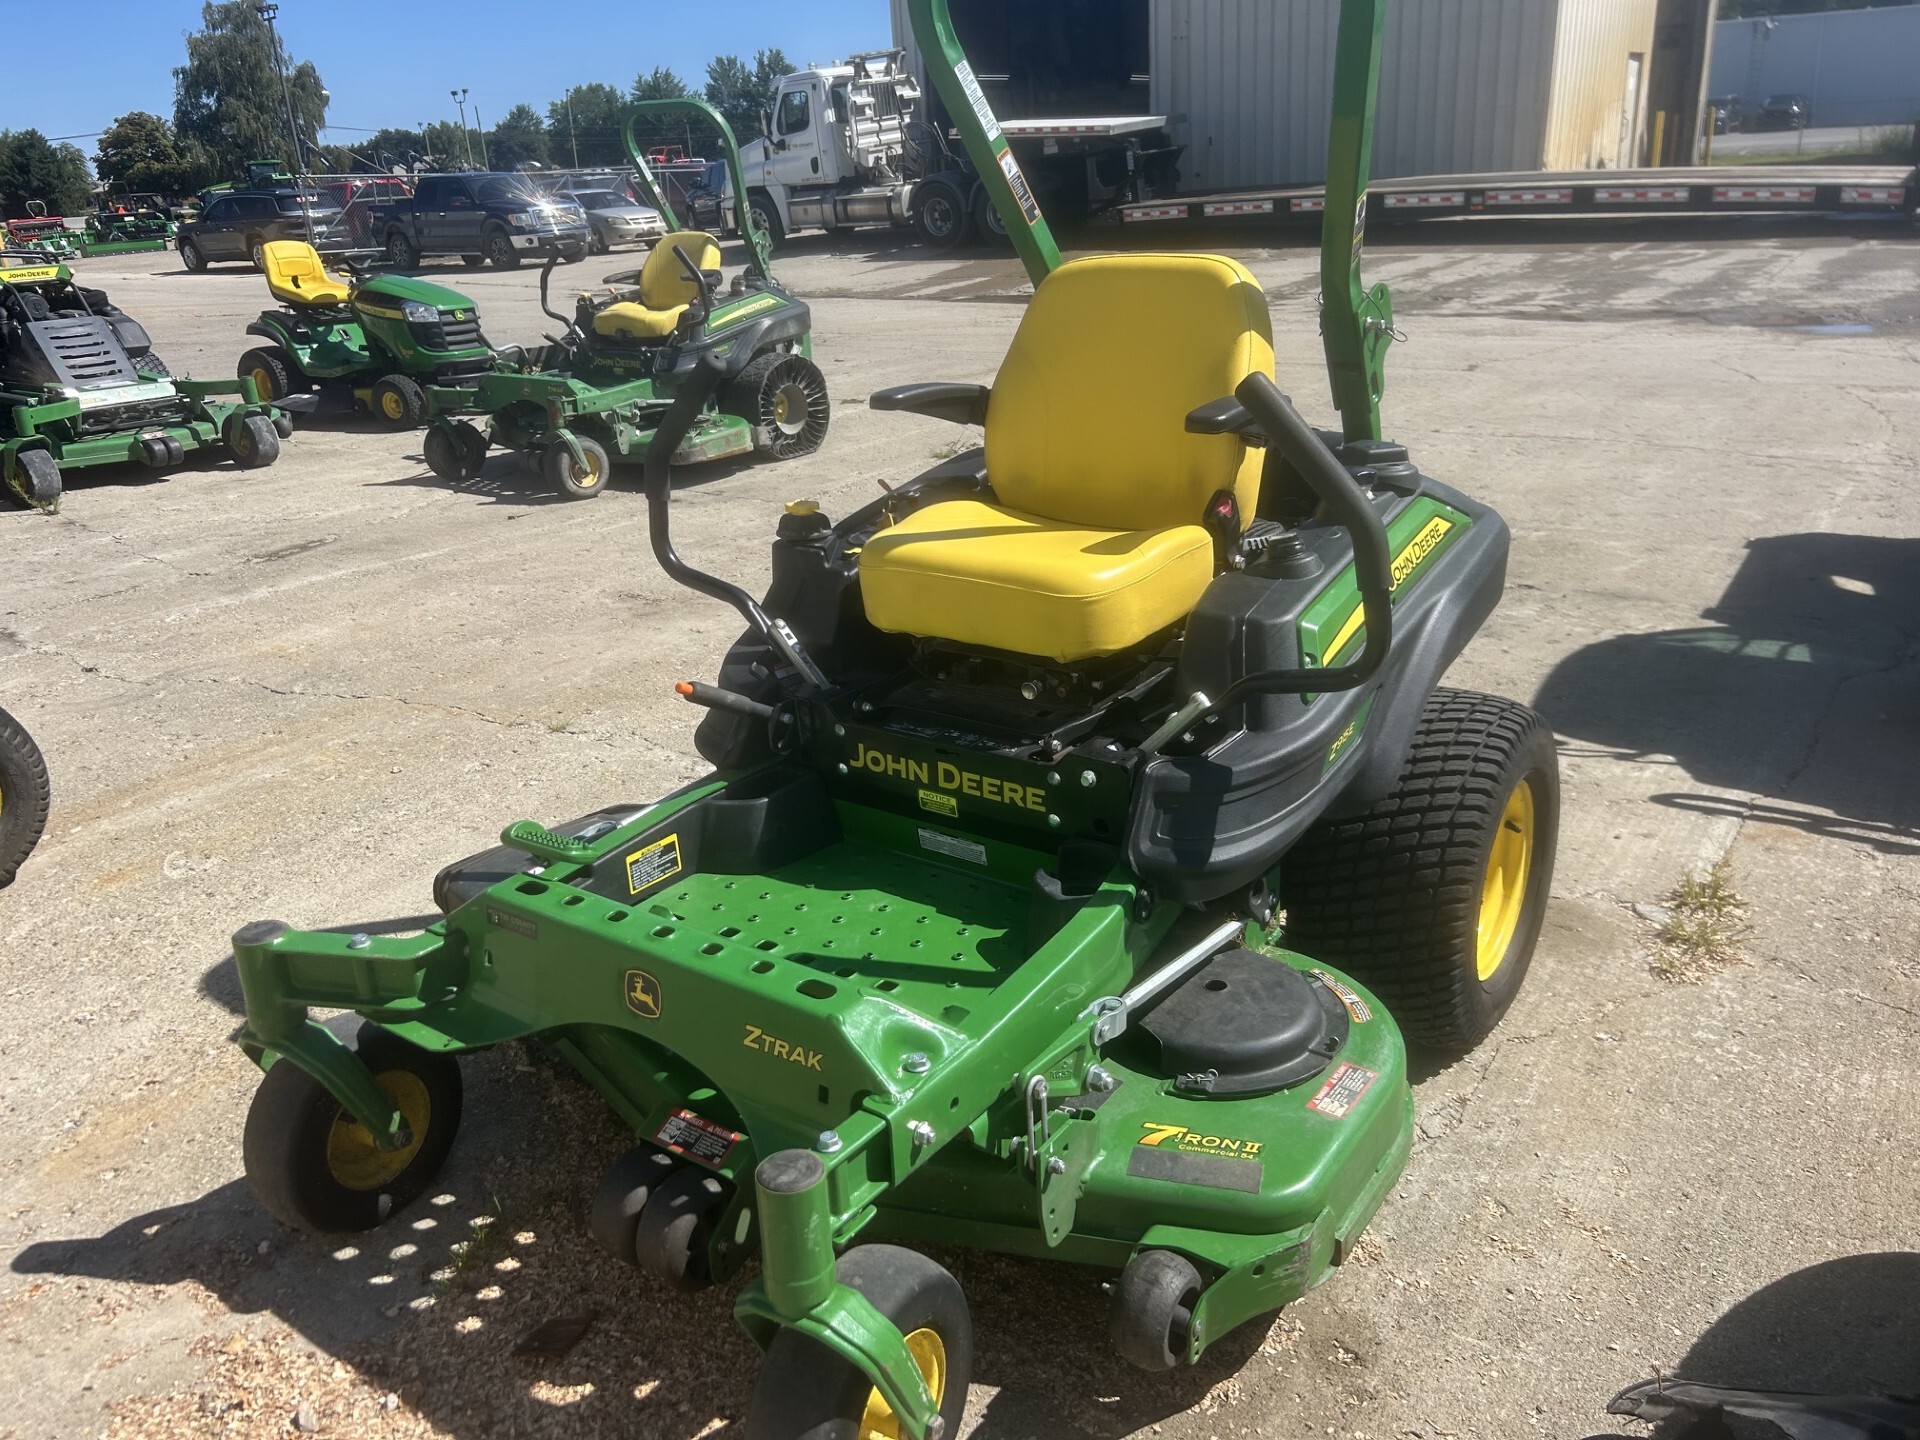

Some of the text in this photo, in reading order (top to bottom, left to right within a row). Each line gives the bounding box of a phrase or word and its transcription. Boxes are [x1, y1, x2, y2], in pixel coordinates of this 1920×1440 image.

[593, 356, 641, 368] JOHN DEERE
[1411, 523, 1442, 562] DEERE
[850, 743, 1046, 812] JOHN DEERE
[923, 792, 952, 803] NOTICE
[743, 1025, 824, 1072] ZTRAK
[1178, 1144, 1254, 1160] Commercial 54
